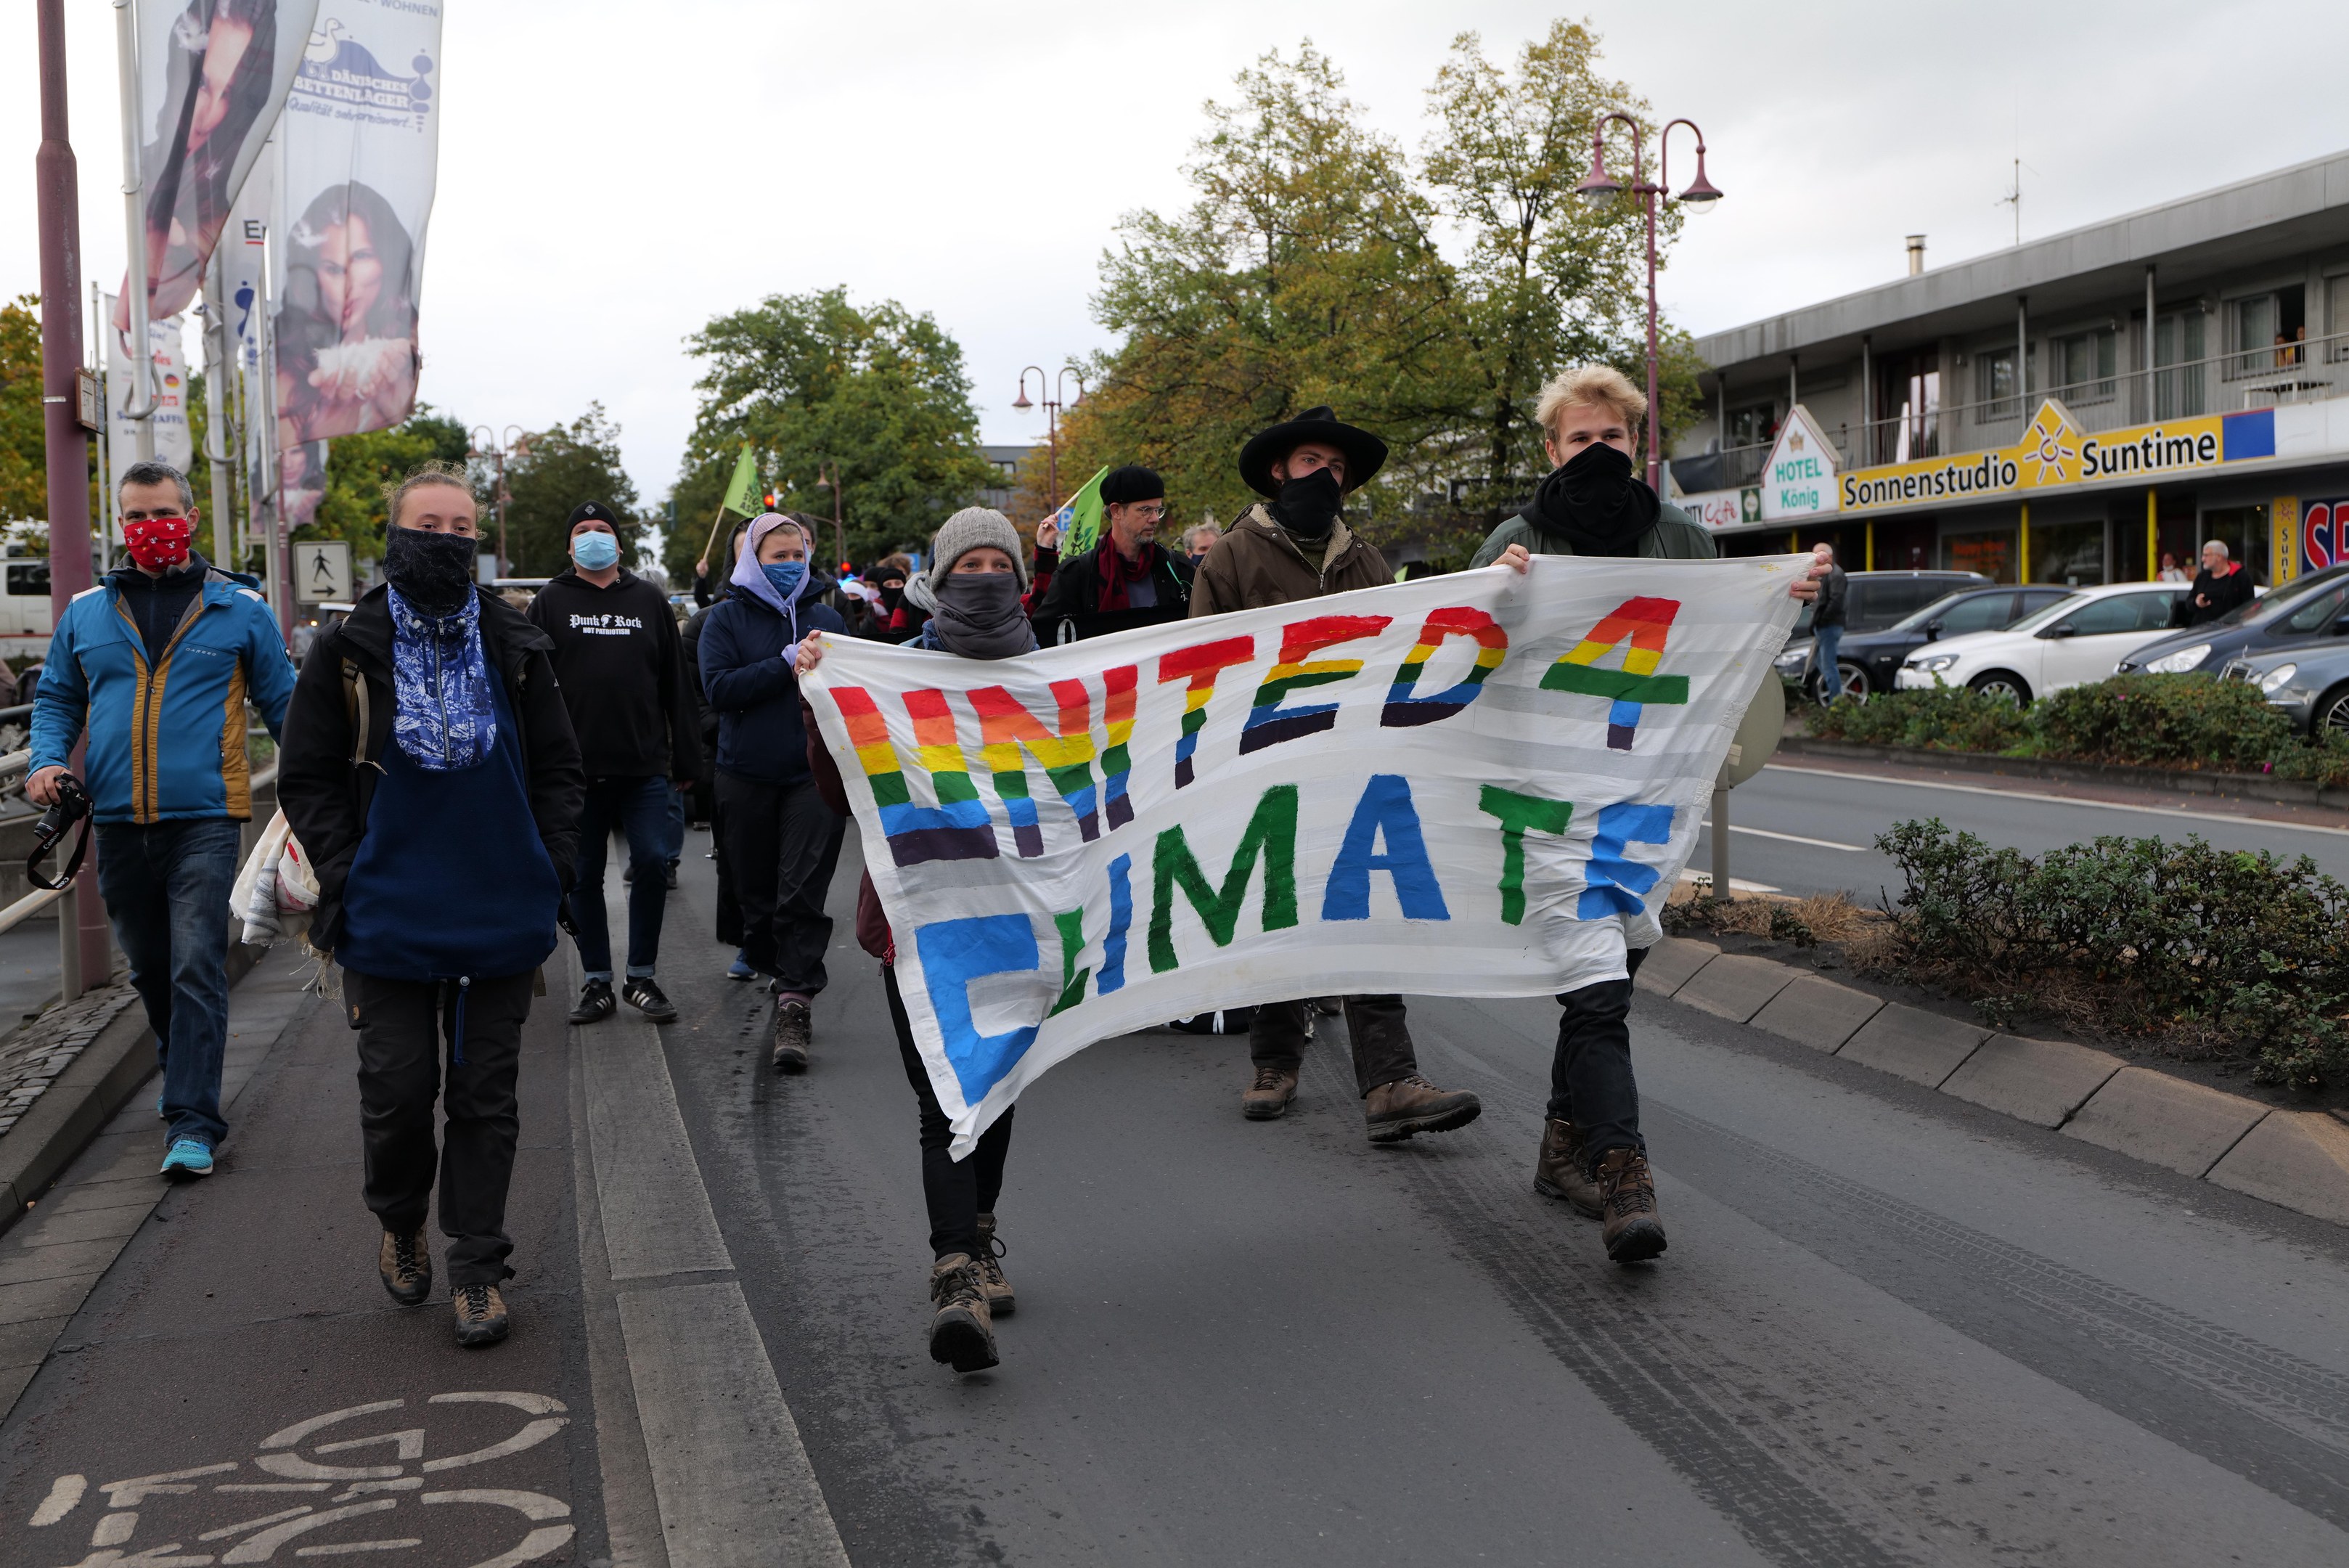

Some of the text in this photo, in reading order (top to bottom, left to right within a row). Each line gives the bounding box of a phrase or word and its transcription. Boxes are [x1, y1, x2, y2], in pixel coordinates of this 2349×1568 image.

[380, 0, 438, 17] WOHNEN
[293, 75, 409, 107] BETTENLAGER
[331, 69, 409, 93] DÄNISCHES
[288, 97, 333, 118] Qualität
[2081, 428, 2216, 476] Suntime
[1776, 457, 1823, 483] HOTEL
[1844, 454, 2018, 507] Sonnenstudio
[1781, 486, 1819, 510] König
[1060, 510, 1072, 530] P
[569, 614, 642, 629] Punk Rock
[829, 596, 1691, 867] UNITED 4
[43, 832, 60, 849] Canon
[915, 773, 1676, 1108] CLIMATE
